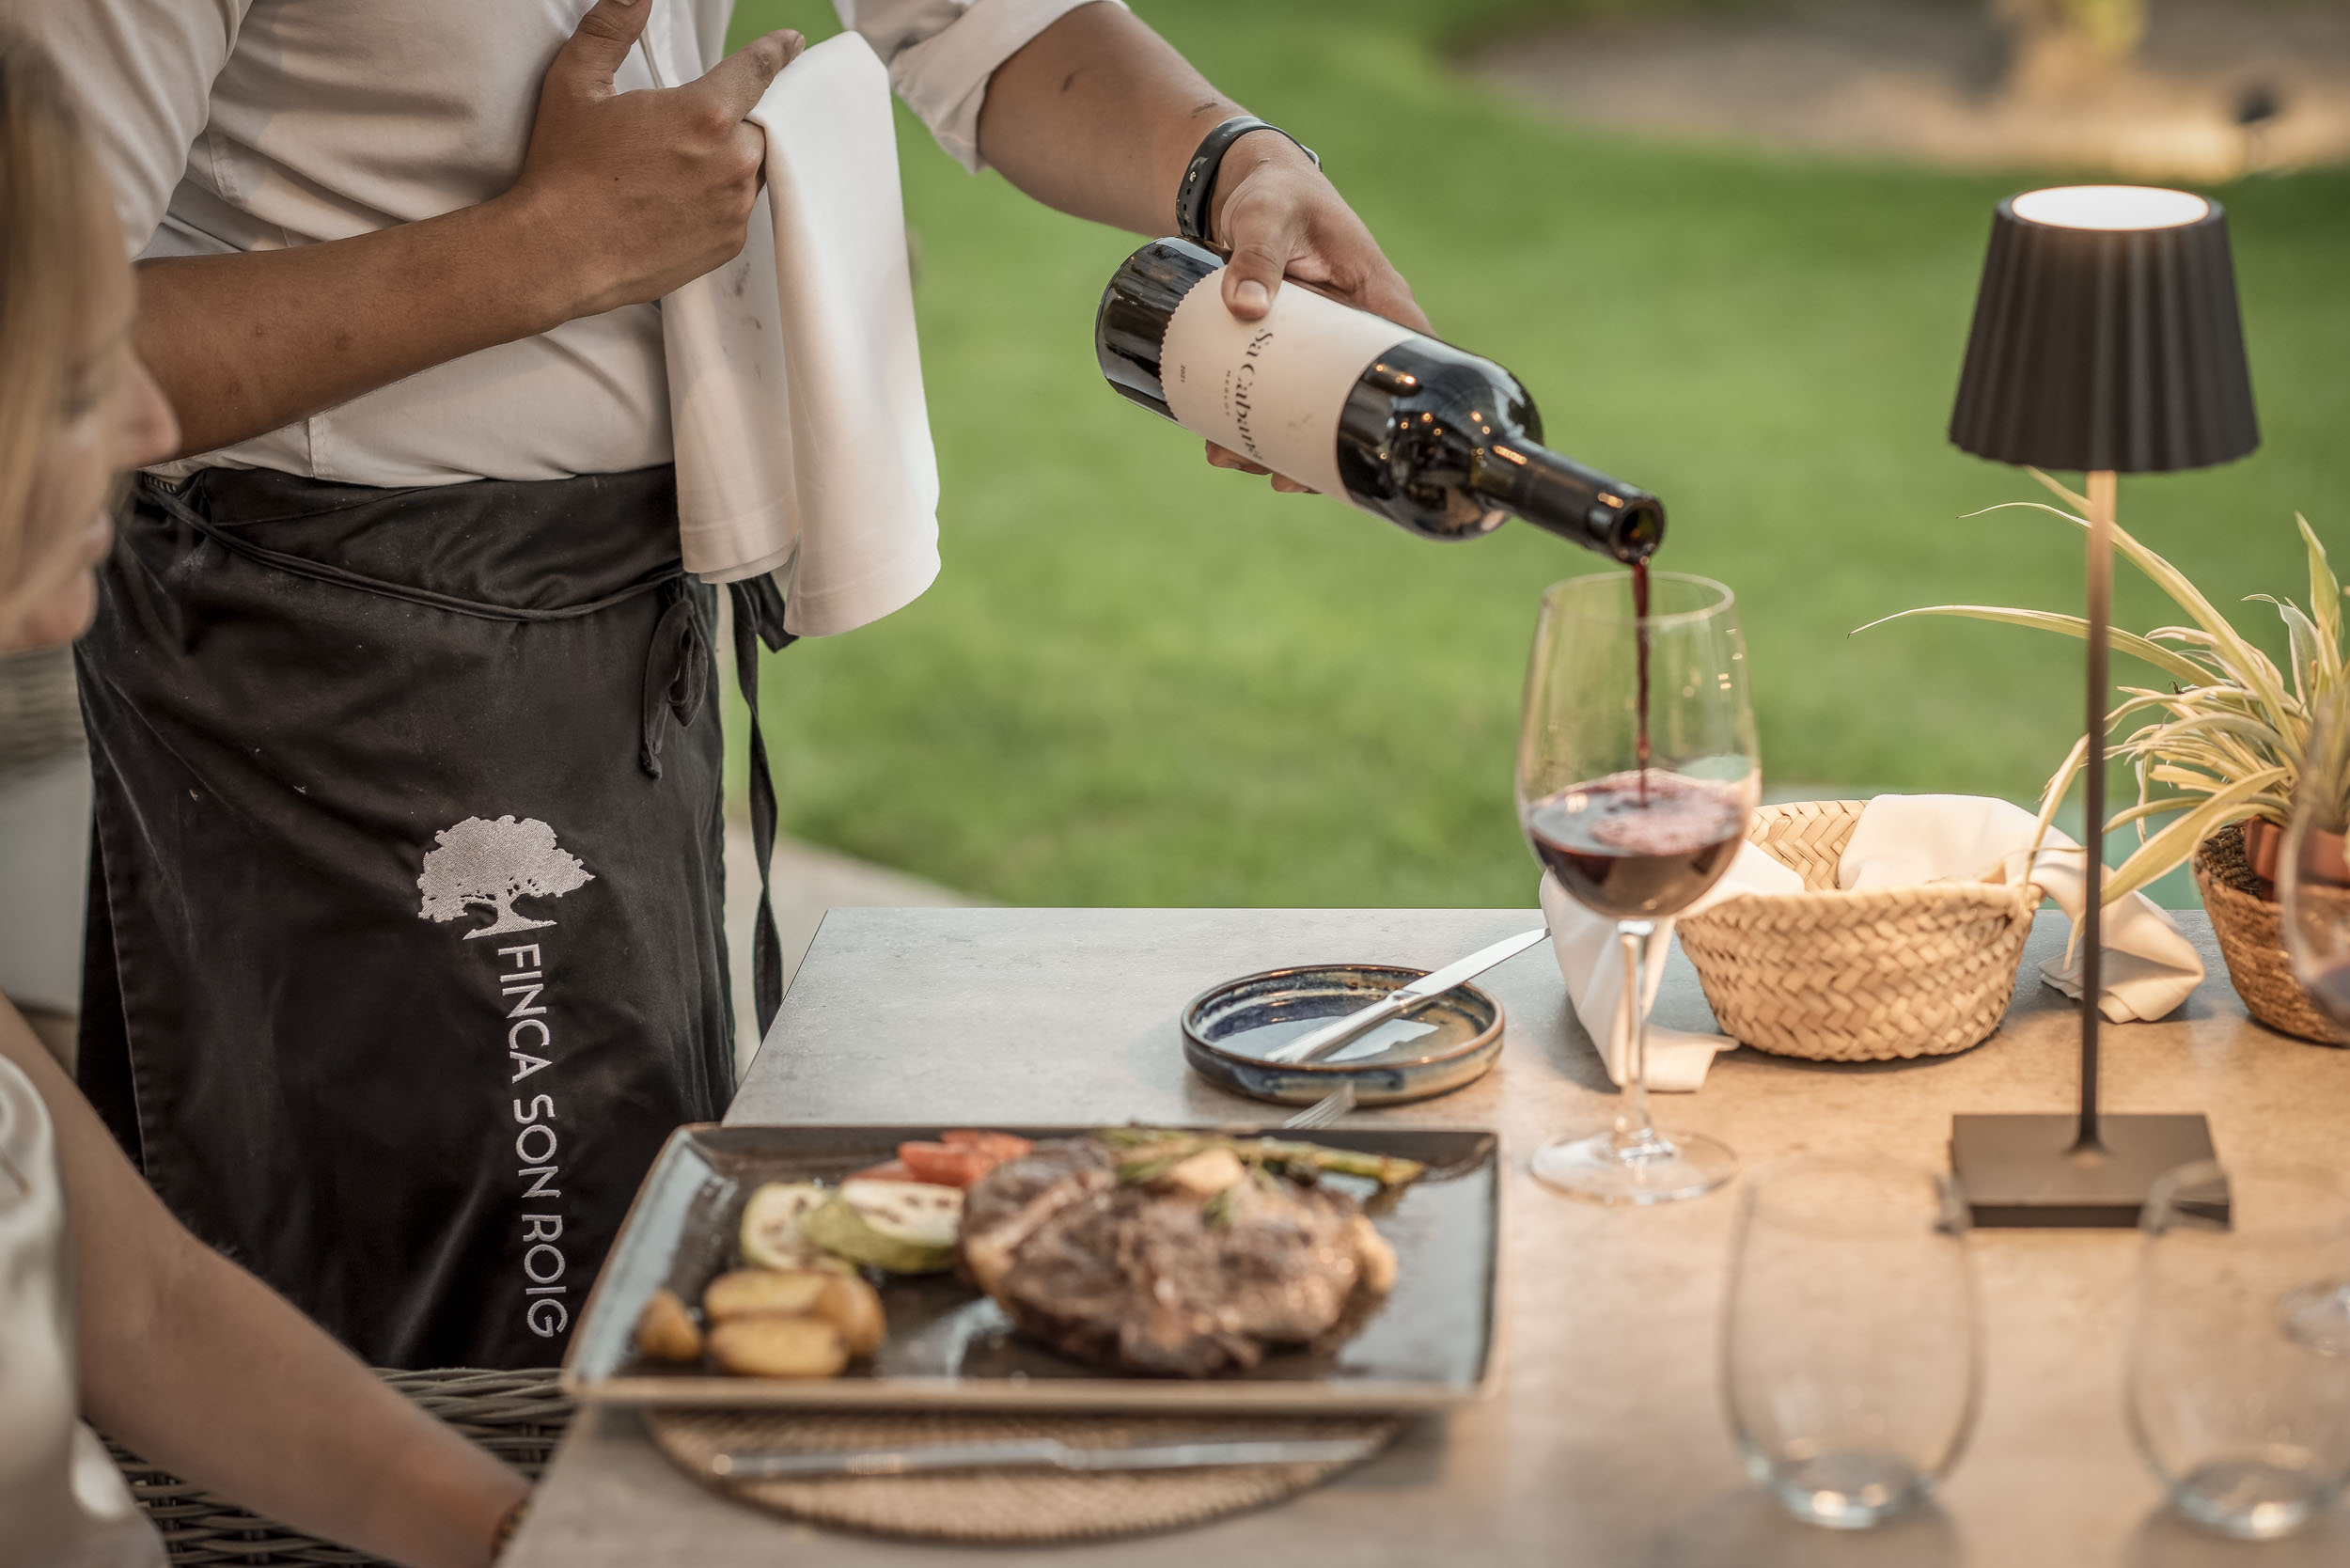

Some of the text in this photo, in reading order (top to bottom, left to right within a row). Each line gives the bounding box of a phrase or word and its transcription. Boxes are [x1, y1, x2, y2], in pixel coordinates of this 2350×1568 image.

[1246, 329, 1274, 357] Sa
[497, 943, 569, 1339] FINCA SON ROIG
